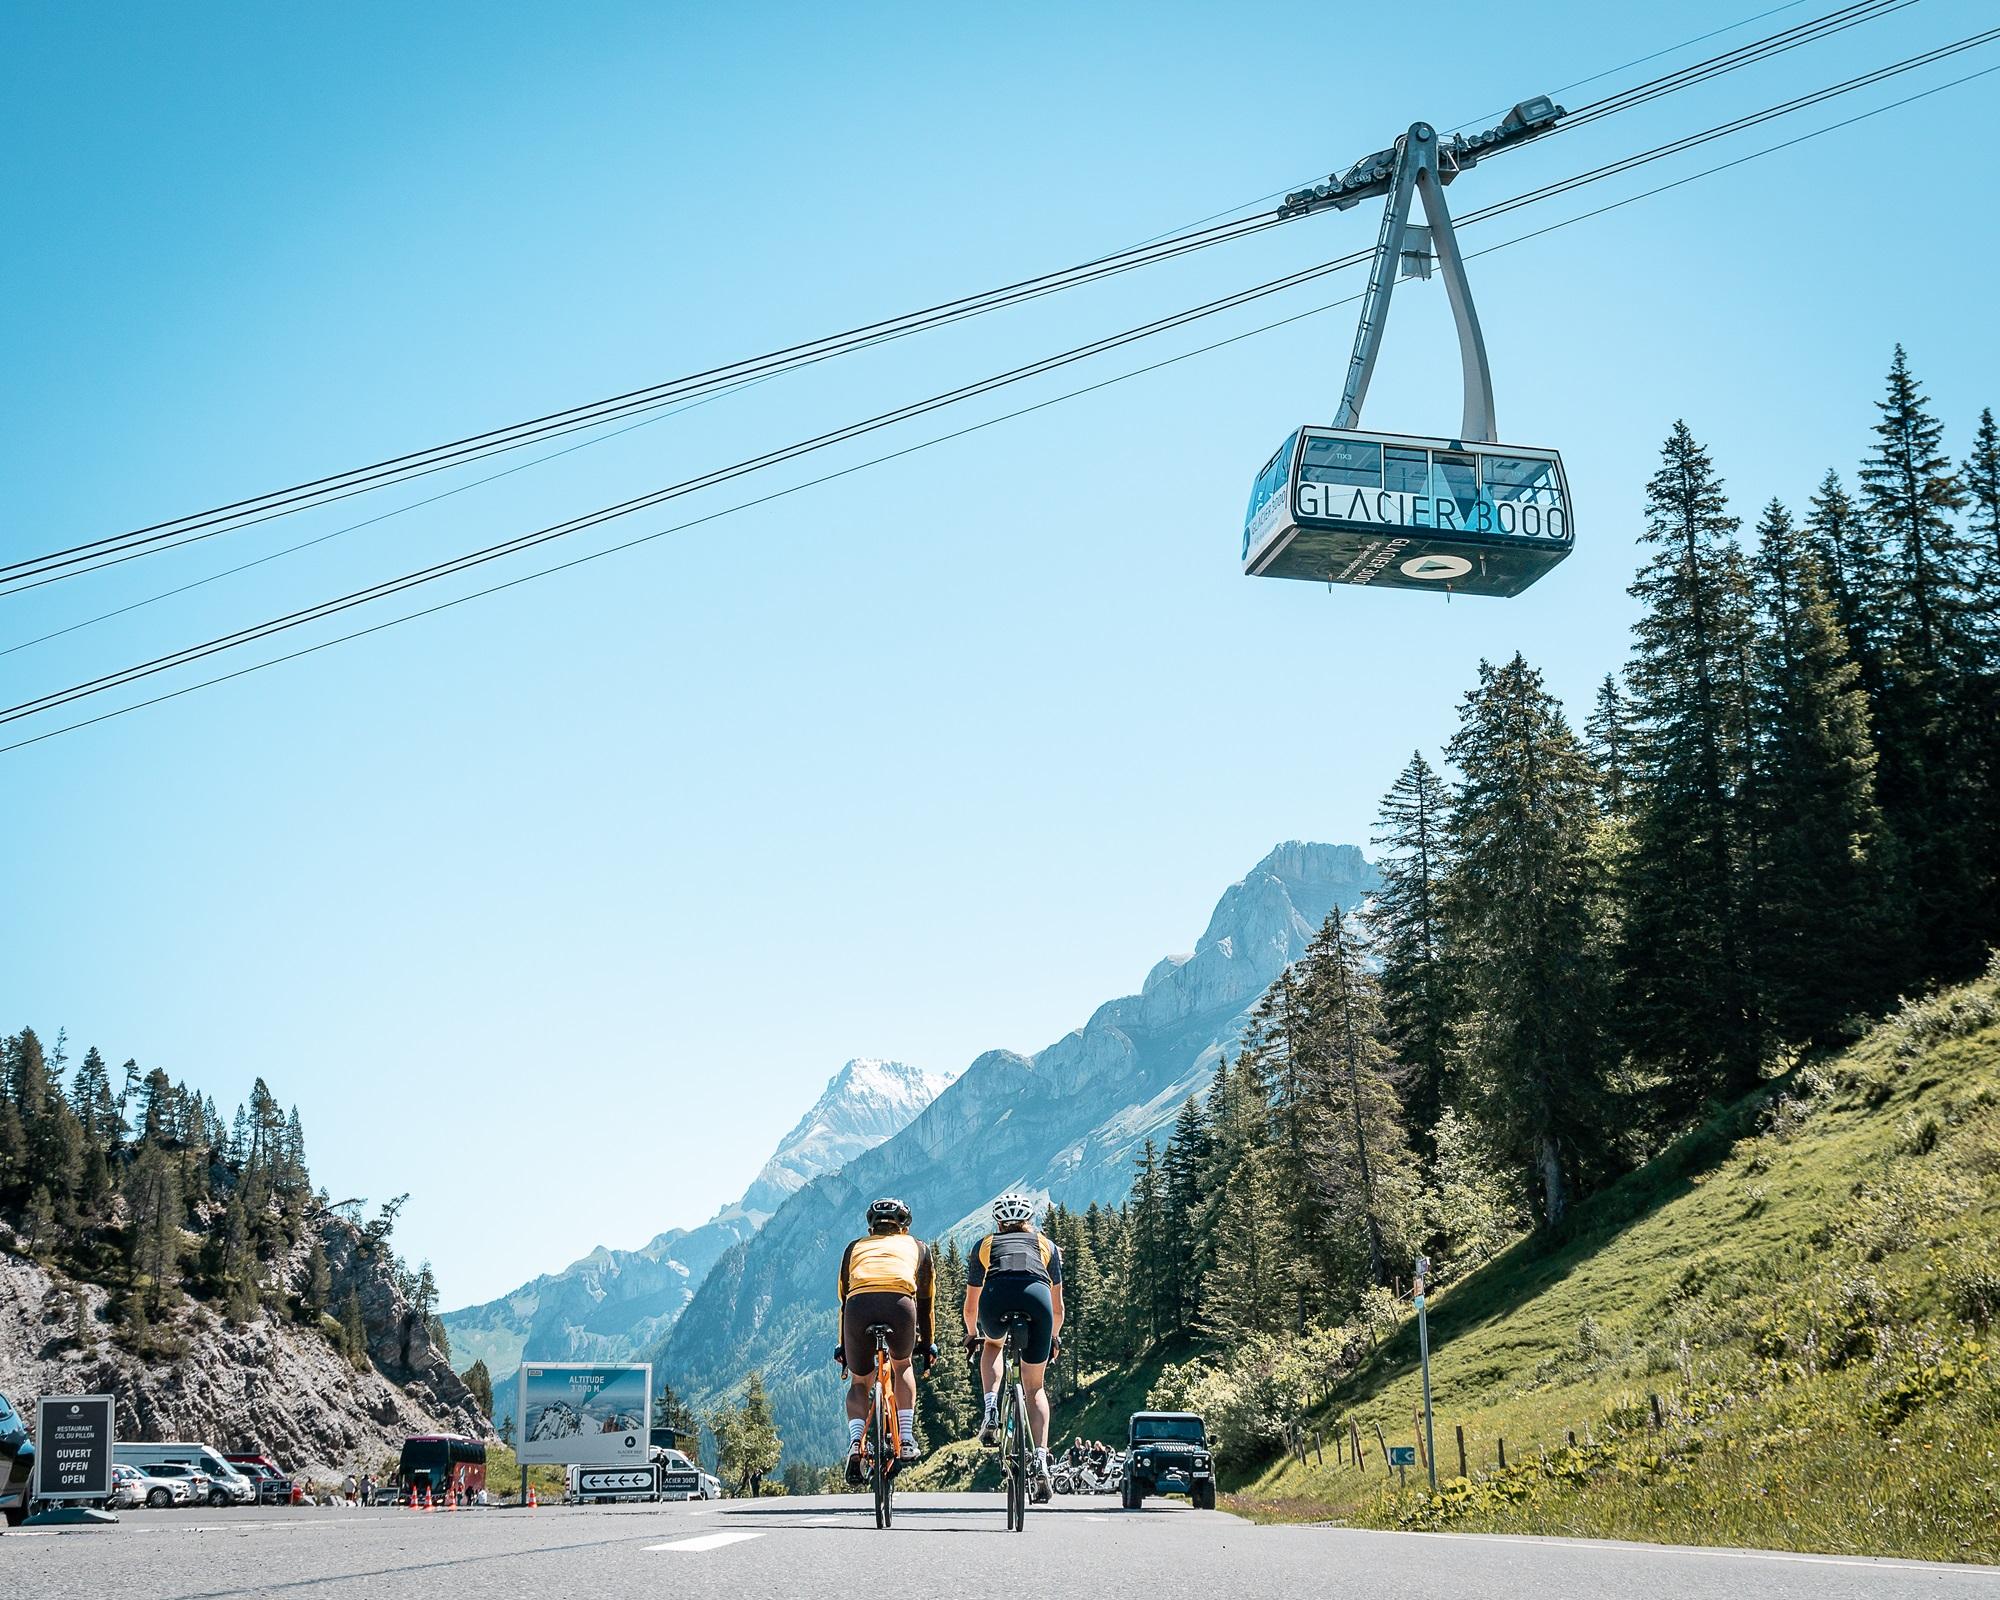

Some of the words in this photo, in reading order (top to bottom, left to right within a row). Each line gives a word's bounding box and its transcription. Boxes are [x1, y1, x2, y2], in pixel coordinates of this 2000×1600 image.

[1297, 484, 1456, 531] GLACIER
[1475, 501, 1565, 539] 3000
[1366, 538, 1410, 569] GLACIER
[569, 1375, 604, 1384] ALTITUDE
[56, 1449, 92, 1458] OUVERT
[59, 1461, 89, 1472] OFFEN
[61, 1474, 86, 1484] OPEN
